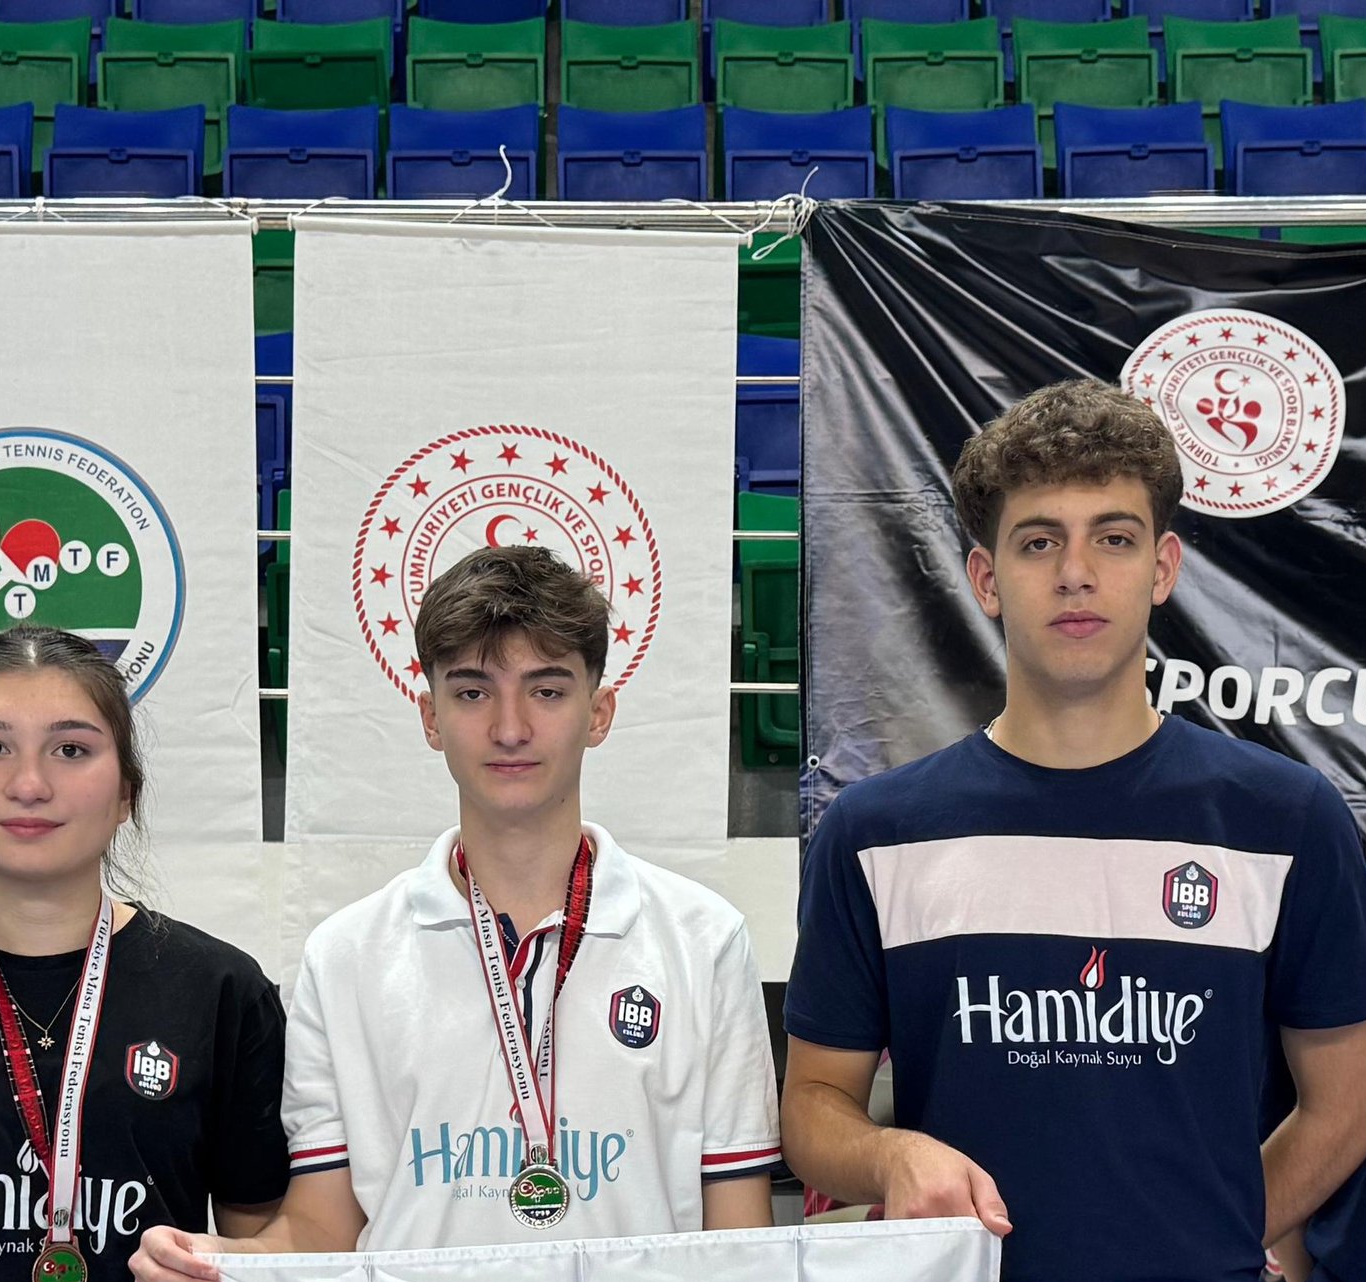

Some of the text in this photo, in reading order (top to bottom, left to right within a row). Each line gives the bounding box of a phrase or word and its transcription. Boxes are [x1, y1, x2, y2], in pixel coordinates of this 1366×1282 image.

[1175, 425, 1219, 467] TÜRKİYE
[1208, 350, 1265, 368] GENÇLİK
[1268, 363, 1286, 379] VE
[1281, 377, 1297, 415] SPOR
[2, 444, 64, 463] TENNIS
[67, 453, 151, 532] FEDERATION
[409, 482, 605, 607] CUMHURİYETİ GENÇLİK VE SPOR
[74, 1014, 92, 1056] Tenisi
[82, 971, 99, 1010] Masa
[489, 950, 507, 999] Tenisi
[499, 1002, 530, 1100] Federasyonu
[953, 974, 1204, 1065] Hamidiye
[1008, 1050, 1142, 1069] Doğal Kaynak Suyu
[60, 1060, 83, 1158] Federasyonu
[407, 1117, 626, 1201] Hamiiye
